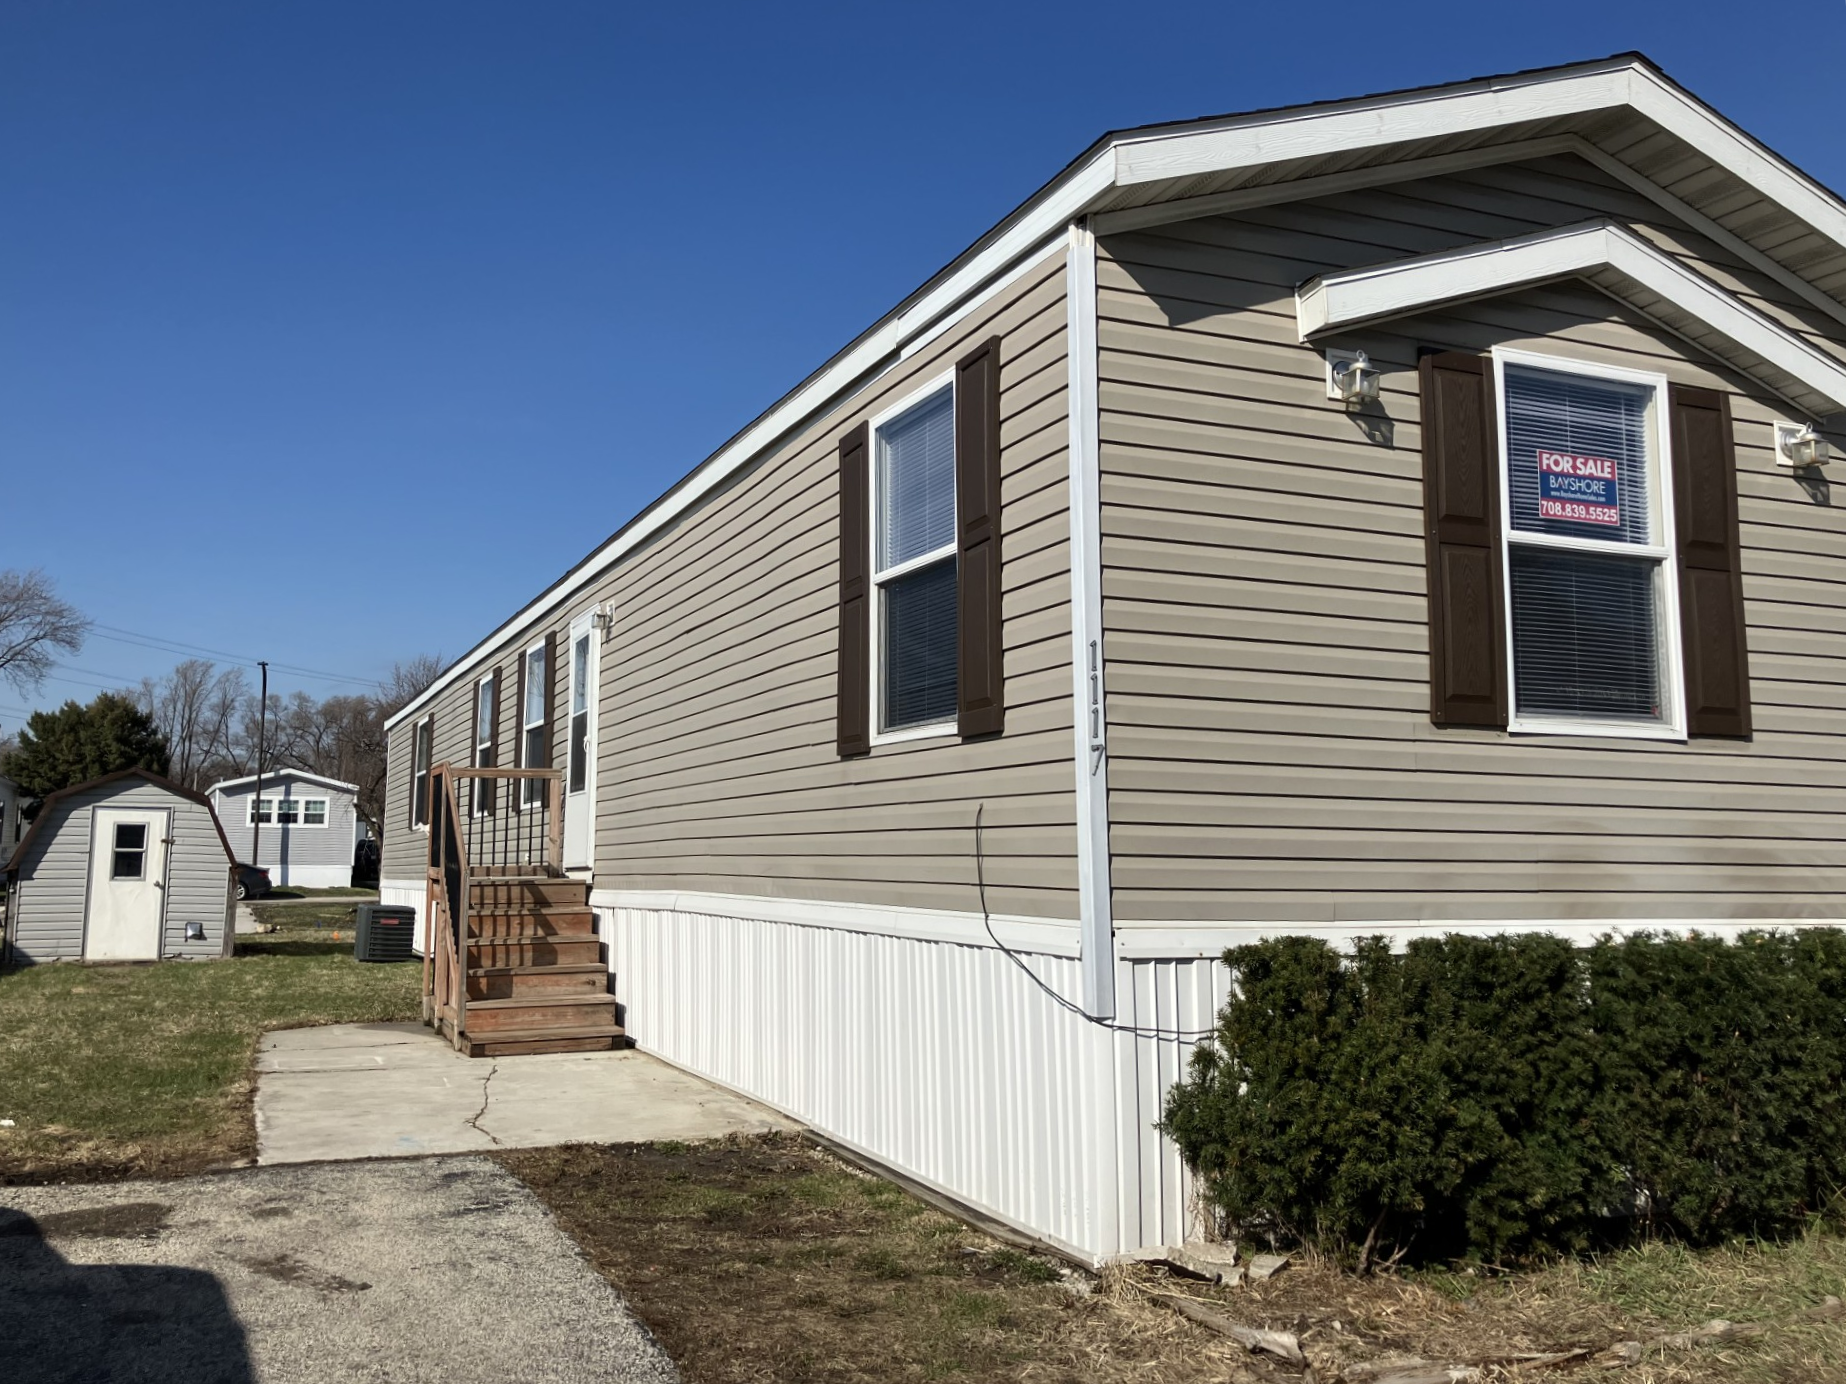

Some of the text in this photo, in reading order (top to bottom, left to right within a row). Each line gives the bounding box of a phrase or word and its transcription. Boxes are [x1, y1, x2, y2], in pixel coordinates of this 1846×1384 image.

[1542, 453, 1612, 478] FOR SALE
[1549, 475, 1606, 494] BAYSHORE
[1541, 500, 1617, 522] 708.839.5525
[1089, 640, 1105, 777] 1117
